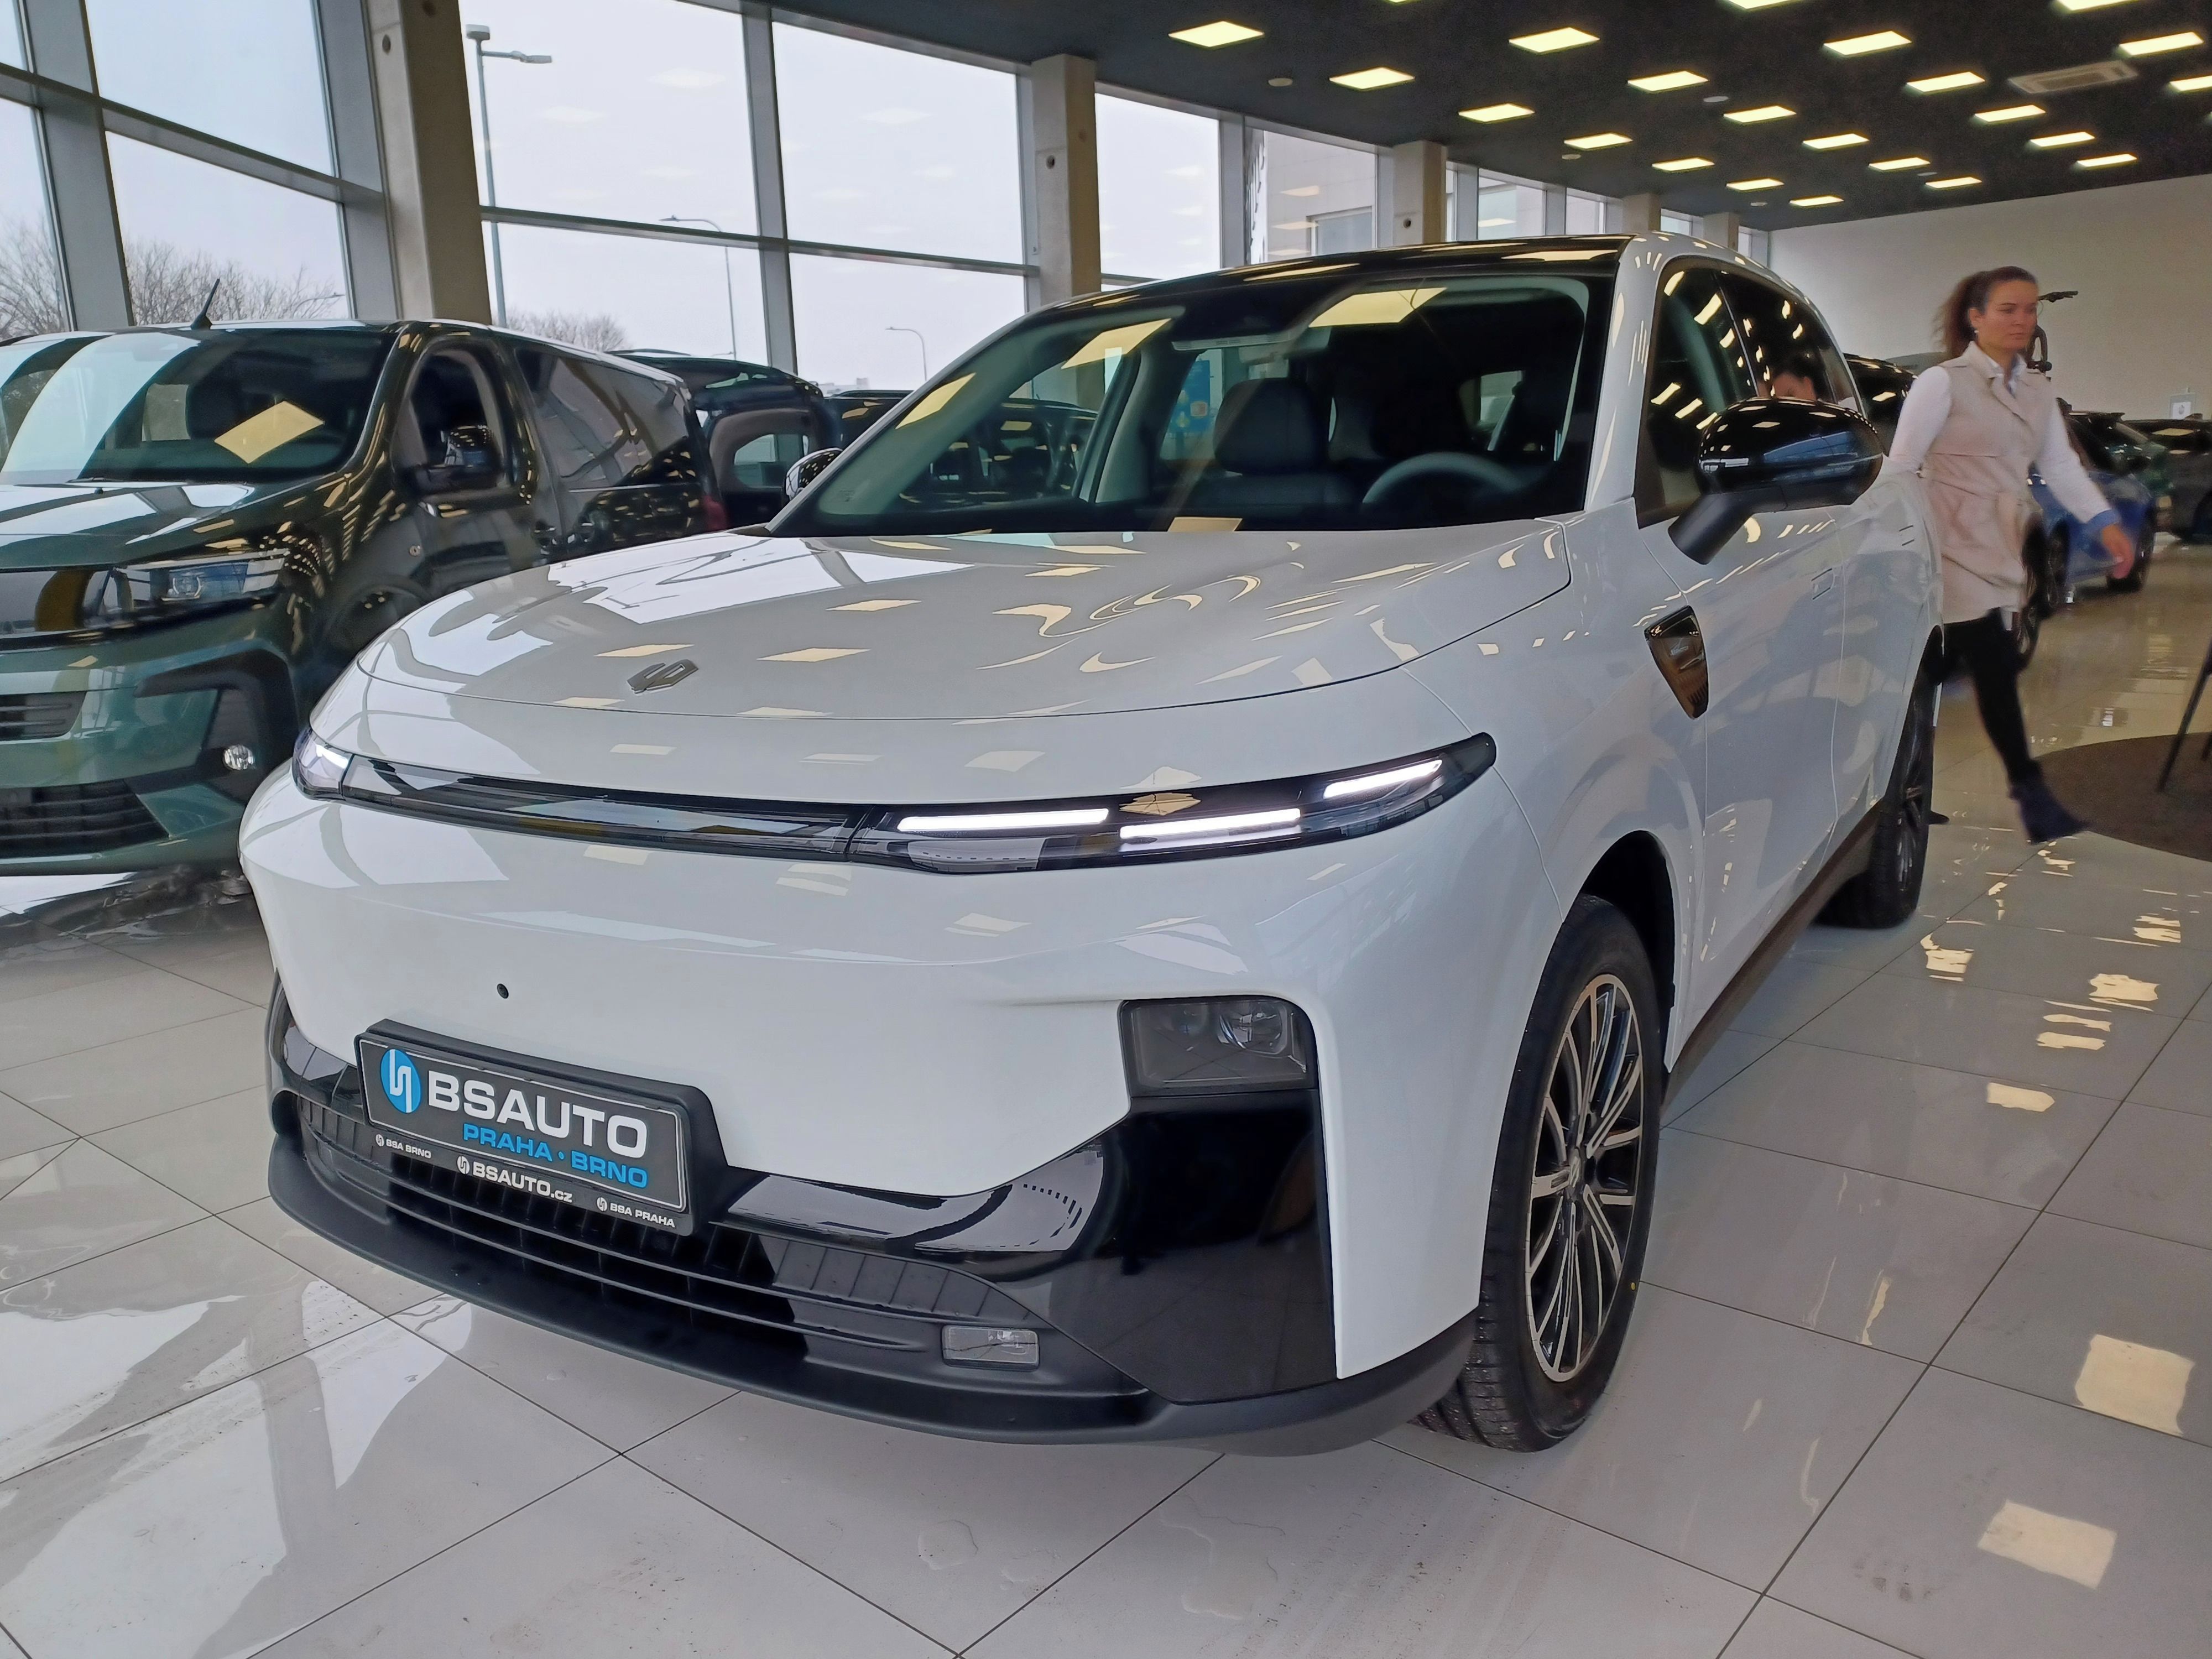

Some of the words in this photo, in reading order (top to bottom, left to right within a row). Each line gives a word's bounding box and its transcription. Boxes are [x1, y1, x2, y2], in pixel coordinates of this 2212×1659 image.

[428, 1070, 648, 1159] BSAUTO
[385, 1139, 404, 1151] BSA
[405, 1144, 432, 1159] BRNO
[463, 1123, 553, 1162] PRAHA
[571, 1150, 648, 1188] BRNO
[609, 1202, 633, 1217] BSA
[635, 1209, 676, 1228] PRAHA
